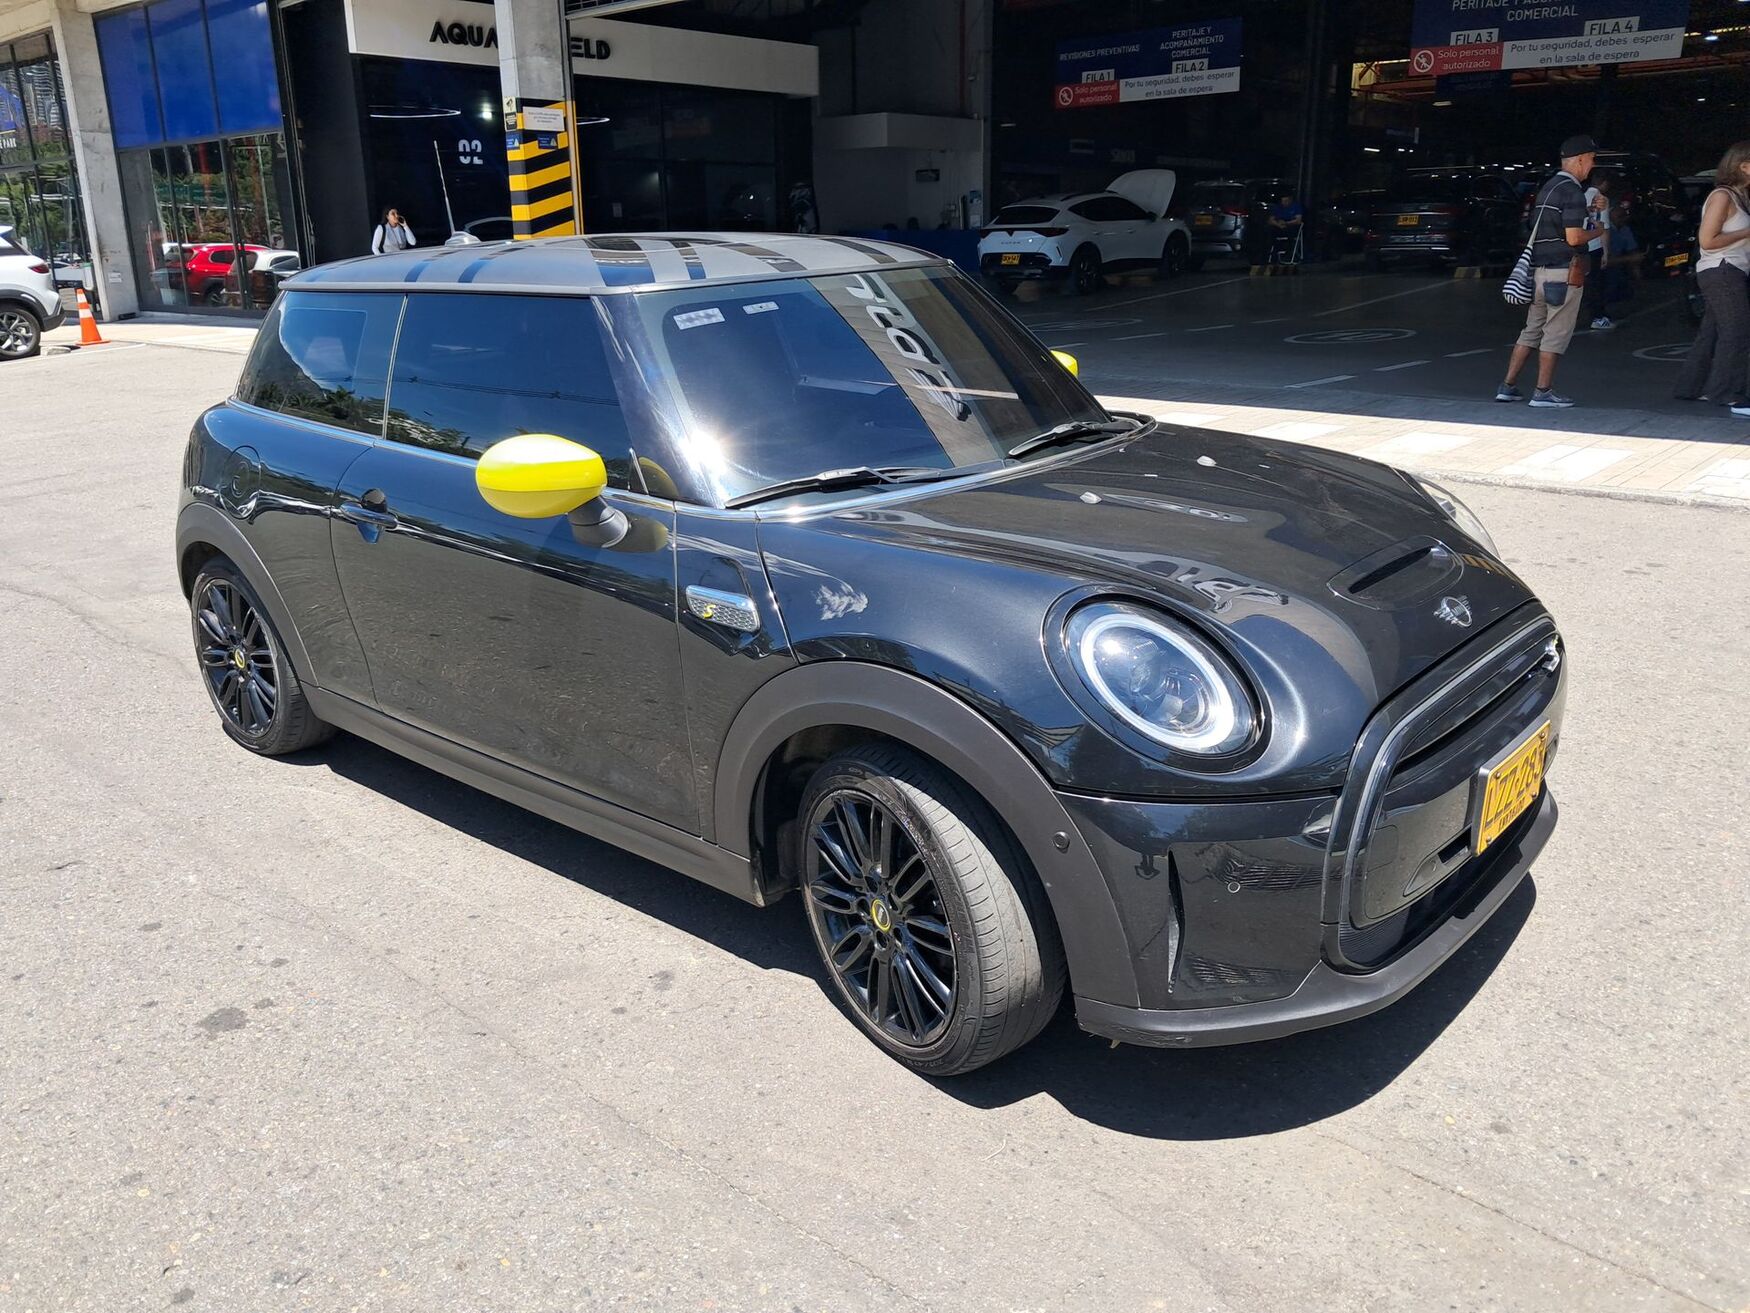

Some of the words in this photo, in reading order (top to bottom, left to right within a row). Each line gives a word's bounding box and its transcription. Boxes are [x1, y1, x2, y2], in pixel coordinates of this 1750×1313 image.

[1507, 5, 1579, 21] COMERCIAL
[1172, 27, 1205, 39] PERITAJE
[1589, 21, 1620, 36] FILA
[1624, 20, 1633, 33] 4
[1455, 33, 1482, 45] FILA
[1486, 31, 1494, 43] 3
[1511, 43, 1527, 53] Por
[1529, 43, 1538, 52] tu
[1595, 37, 1628, 47] debes
[1633, 33, 1676, 45] esperar
[1171, 47, 1211, 58] COMERCIAL
[1438, 49, 1457, 59] Solo
[1460, 45, 1499, 58] personal
[1540, 56, 1552, 64] en
[1555, 54, 1563, 64] la
[1566, 52, 1585, 63] sala
[1588, 51, 1601, 61] de
[1604, 50, 1640, 61] espera
[1175, 62, 1197, 75] FILA
[1199, 61, 1206, 72] 2
[1443, 59, 1491, 70] autorizado
[1086, 72, 1105, 83] FILA
[1207, 71, 1235, 82] esperar
[458, 139, 483, 164] 02
